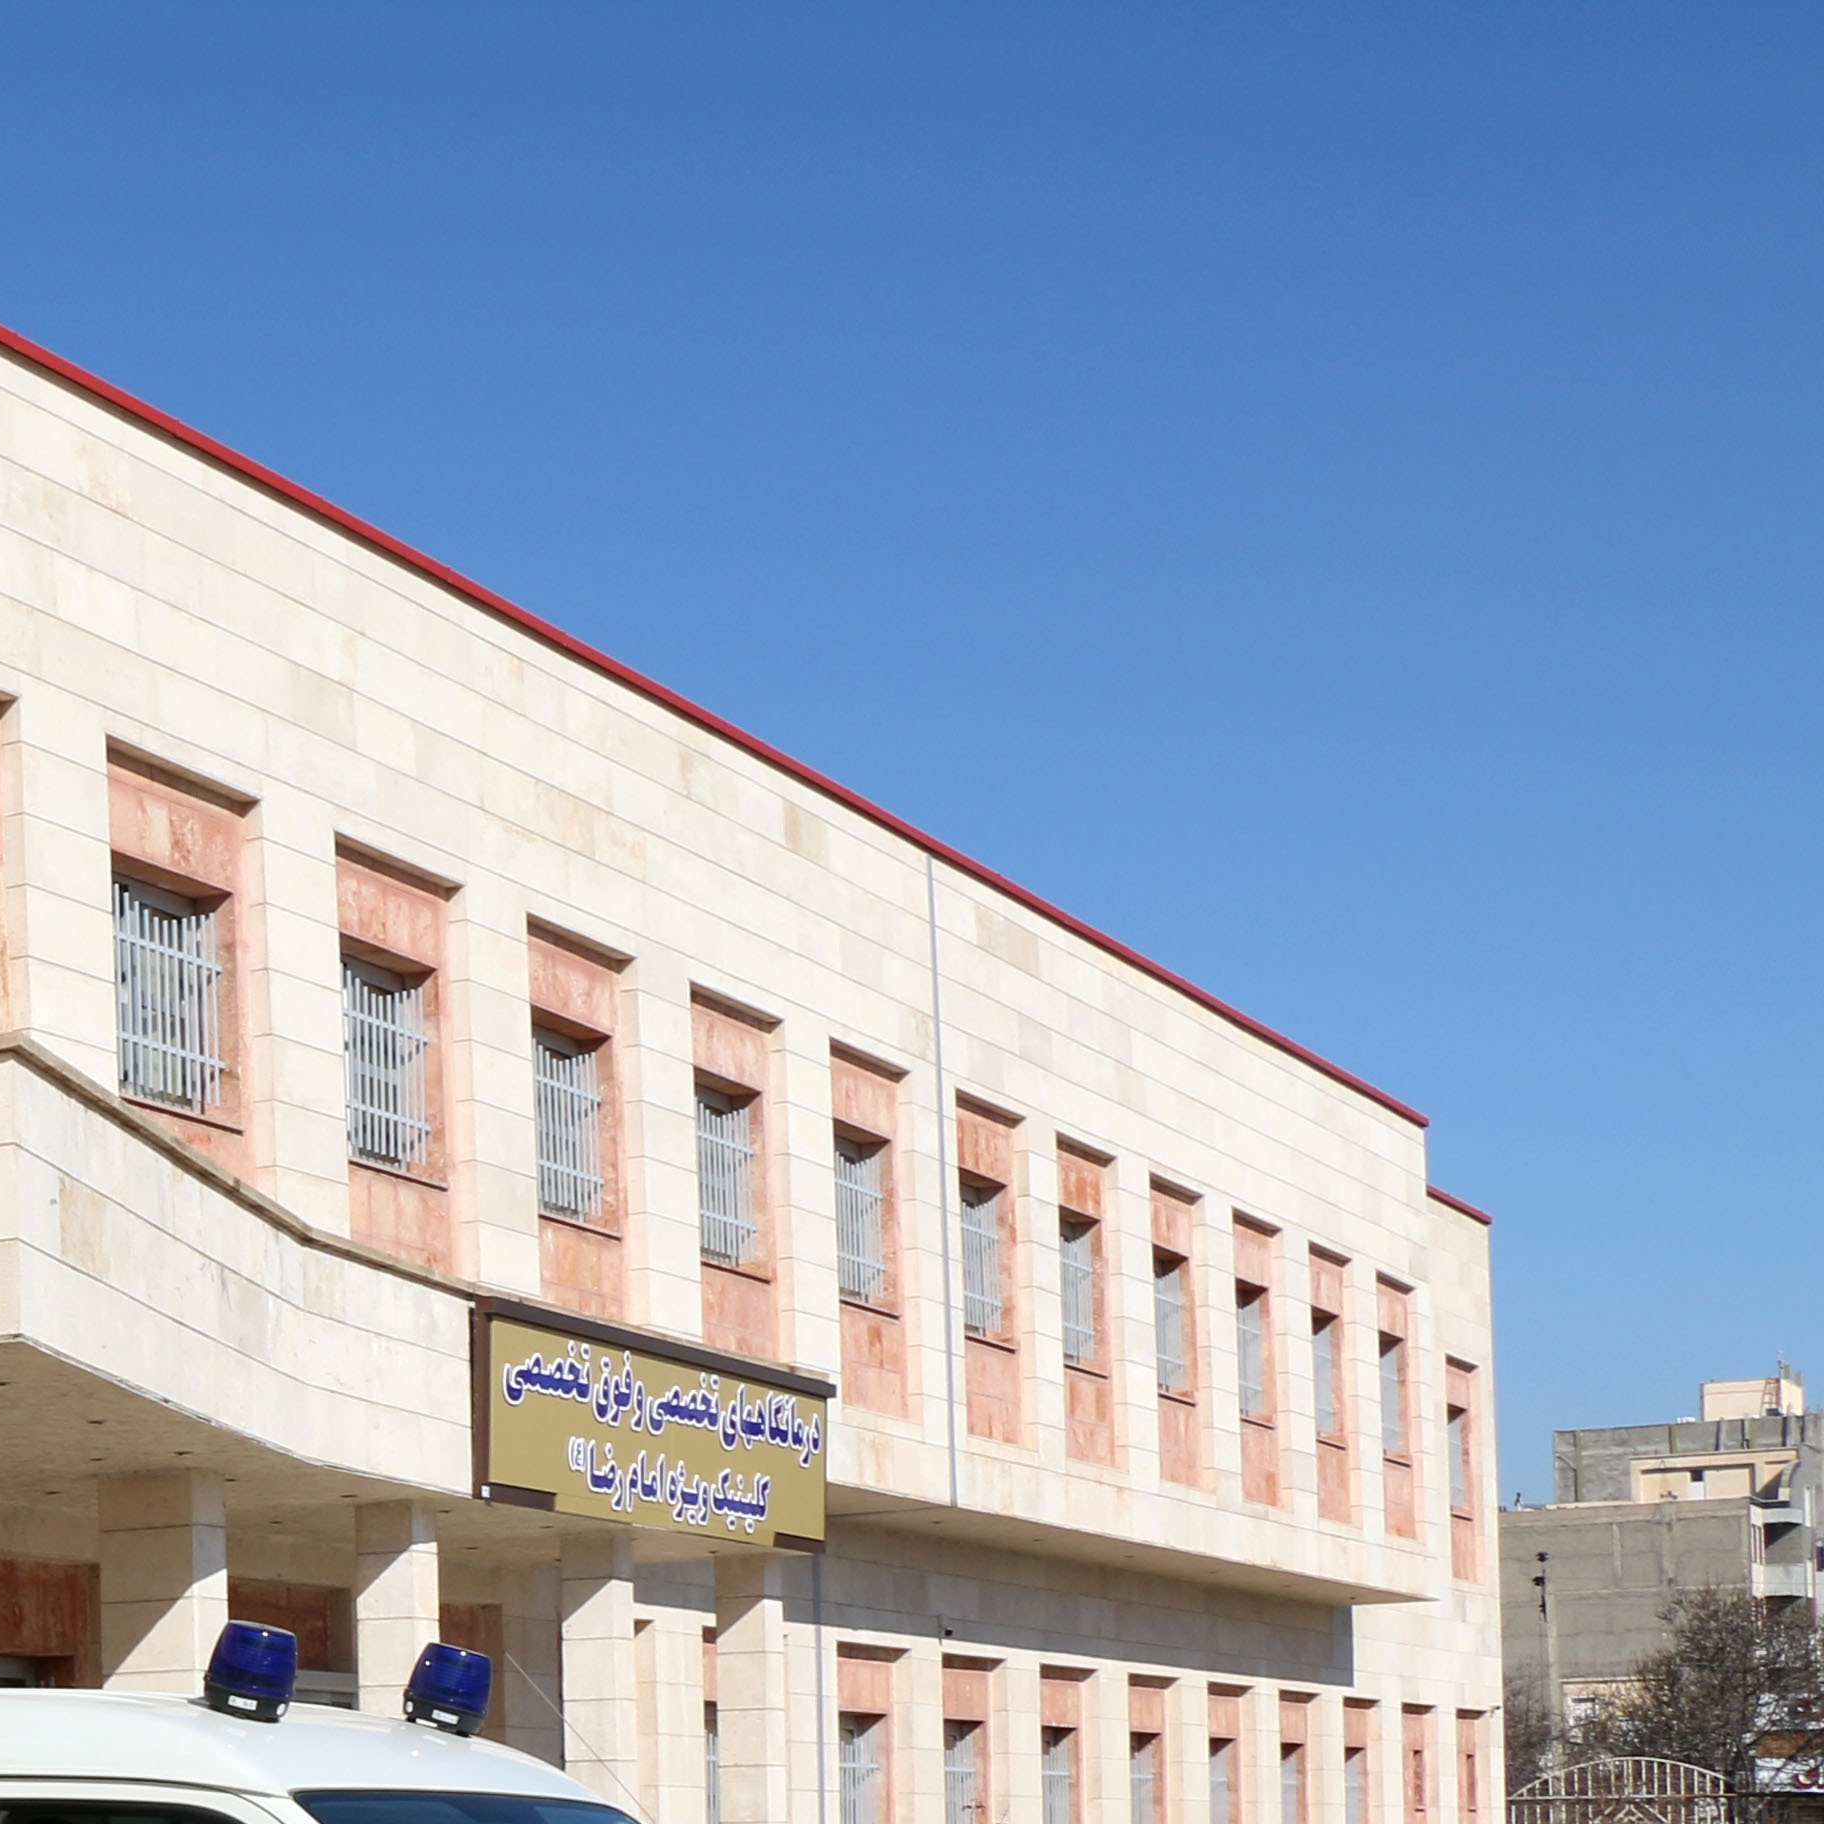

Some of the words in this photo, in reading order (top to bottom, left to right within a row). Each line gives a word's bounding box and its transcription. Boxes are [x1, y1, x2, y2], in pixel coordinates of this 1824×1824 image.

[503, 1340, 592, 1406] تخصصی
[593, 1350, 633, 1427] فوق
[646, 1372, 721, 1435] تخصصی
[631, 1381, 644, 1432] و
[587, 1437, 623, 1510] رضا
[626, 1450, 665, 1512] امام
[667, 1460, 709, 1525] ویژه
[711, 1468, 770, 1533] کلینیک
